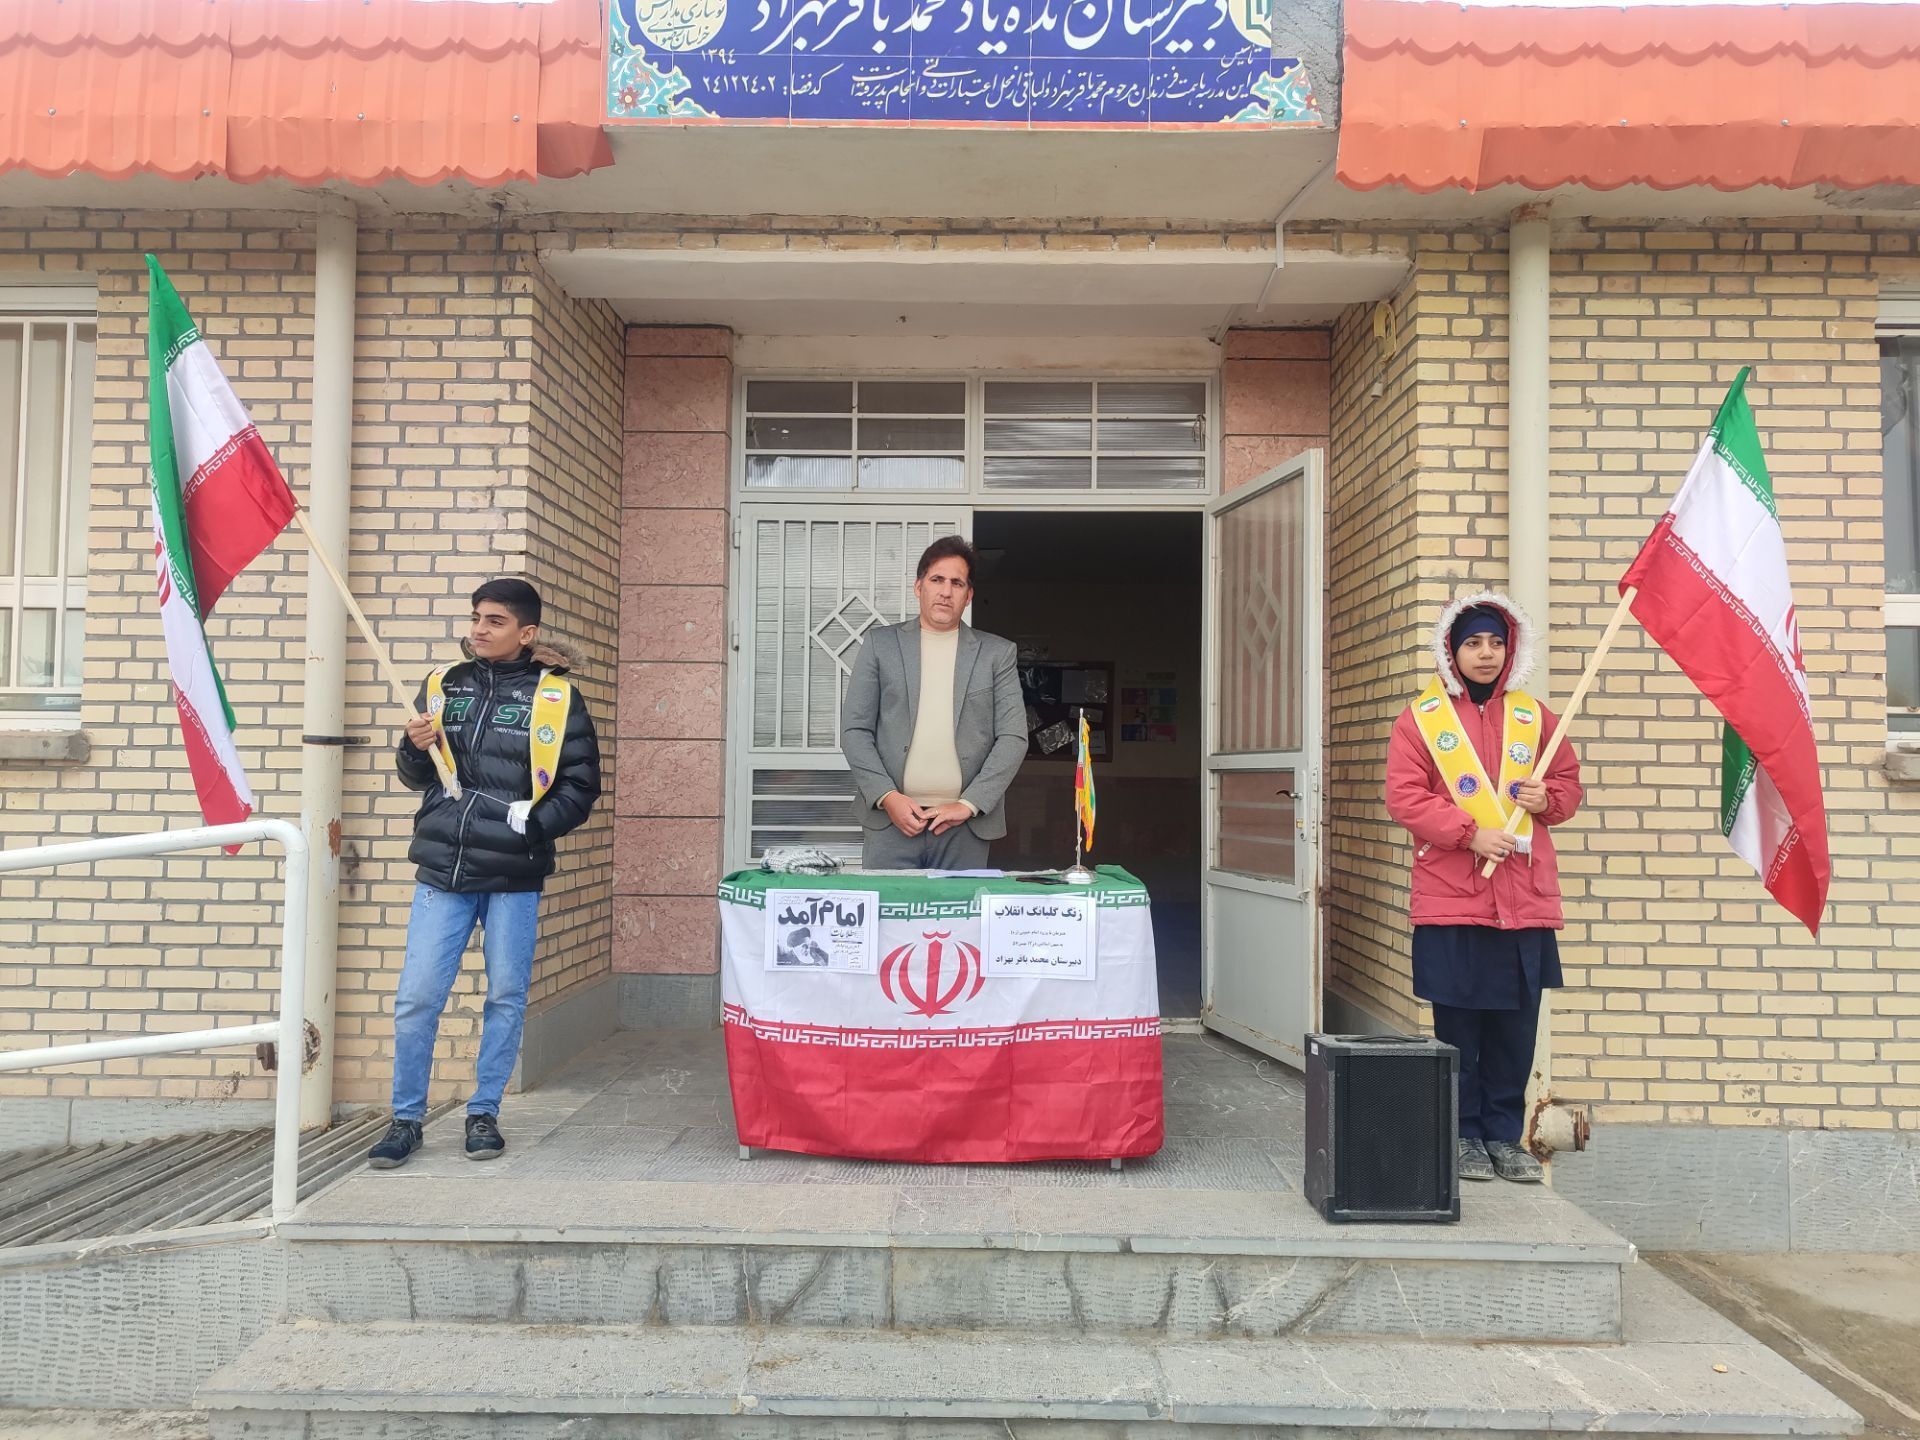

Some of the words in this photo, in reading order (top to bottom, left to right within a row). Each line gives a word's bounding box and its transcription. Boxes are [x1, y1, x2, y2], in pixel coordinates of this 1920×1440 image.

[778, 896, 824, 926] آمد
[818, 899, 865, 927] امام
[994, 905, 1024, 919] انقلاب
